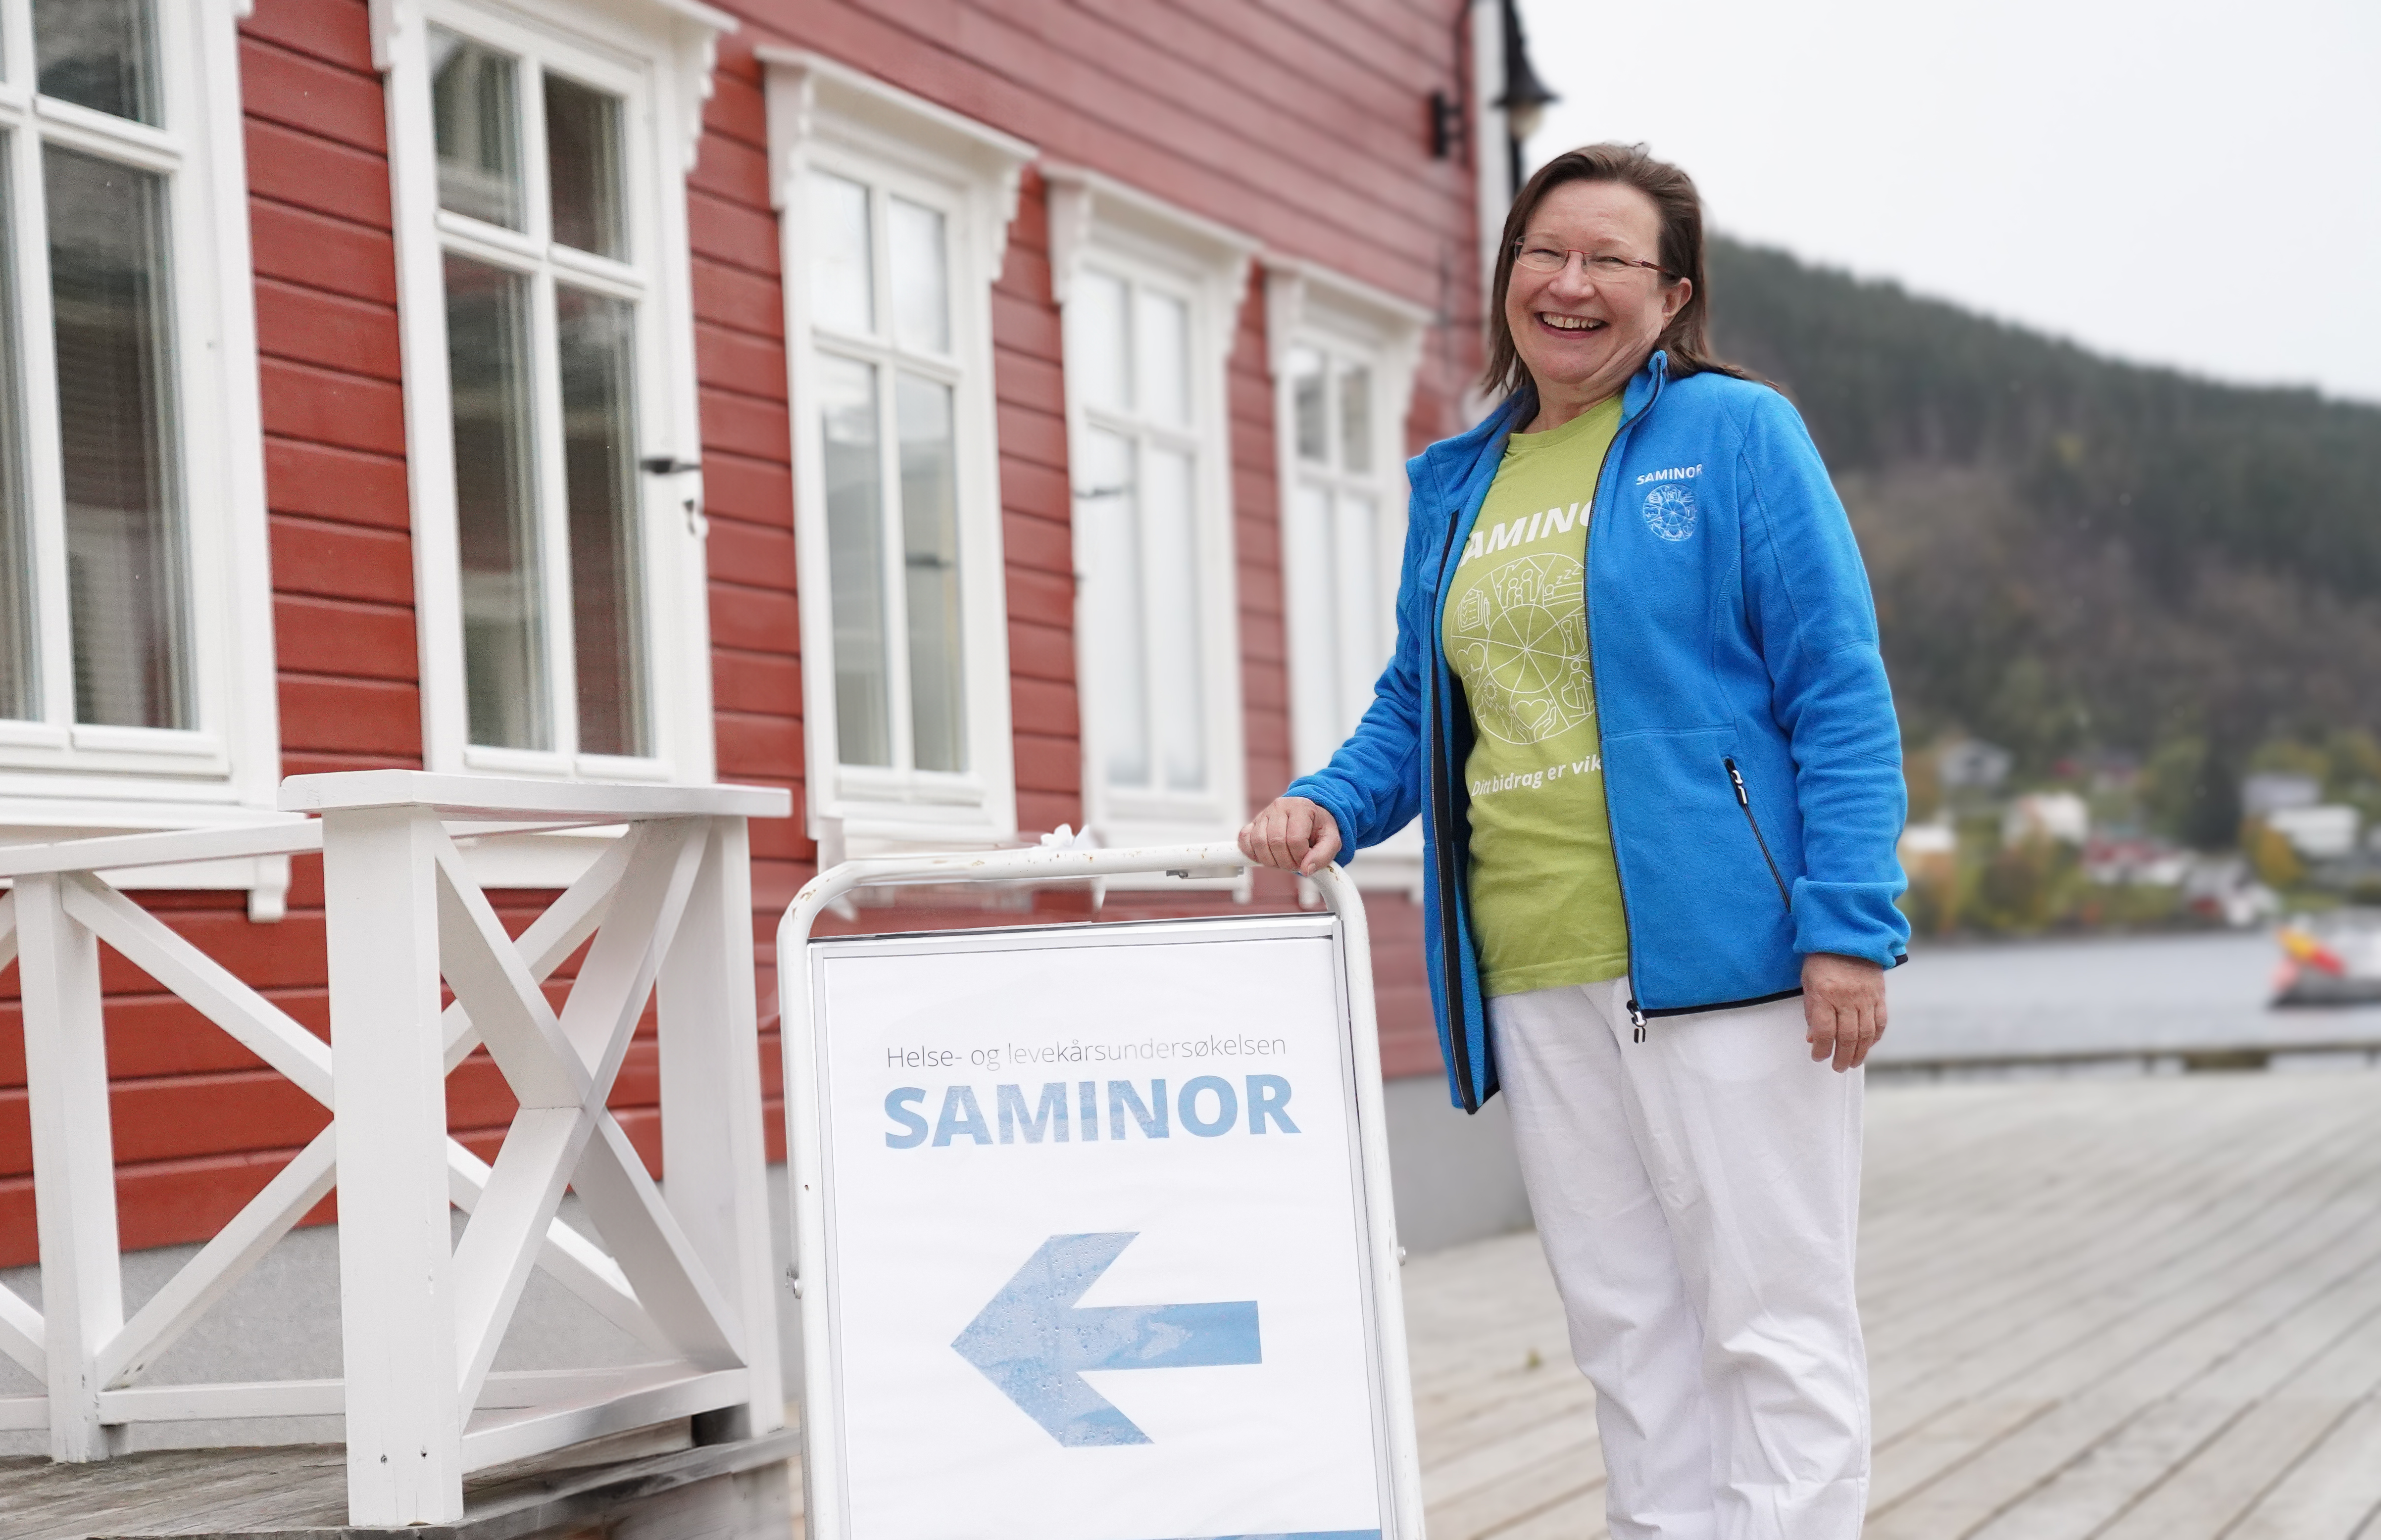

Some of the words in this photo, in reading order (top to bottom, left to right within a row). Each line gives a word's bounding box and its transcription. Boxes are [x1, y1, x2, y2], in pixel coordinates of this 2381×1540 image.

[1636, 463, 1703, 485] SAMINOR
[1457, 499, 1592, 569] AMIN
[1471, 779, 1491, 797] Ditt
[1492, 772, 1544, 792] bidrag
[1547, 764, 1566, 780] er
[887, 1045, 963, 1068] Helse-
[971, 1049, 1000, 1071] og
[1008, 1033, 1286, 1064] levekårsundersøkelsen
[884, 1074, 1302, 1150] SAMINOR
